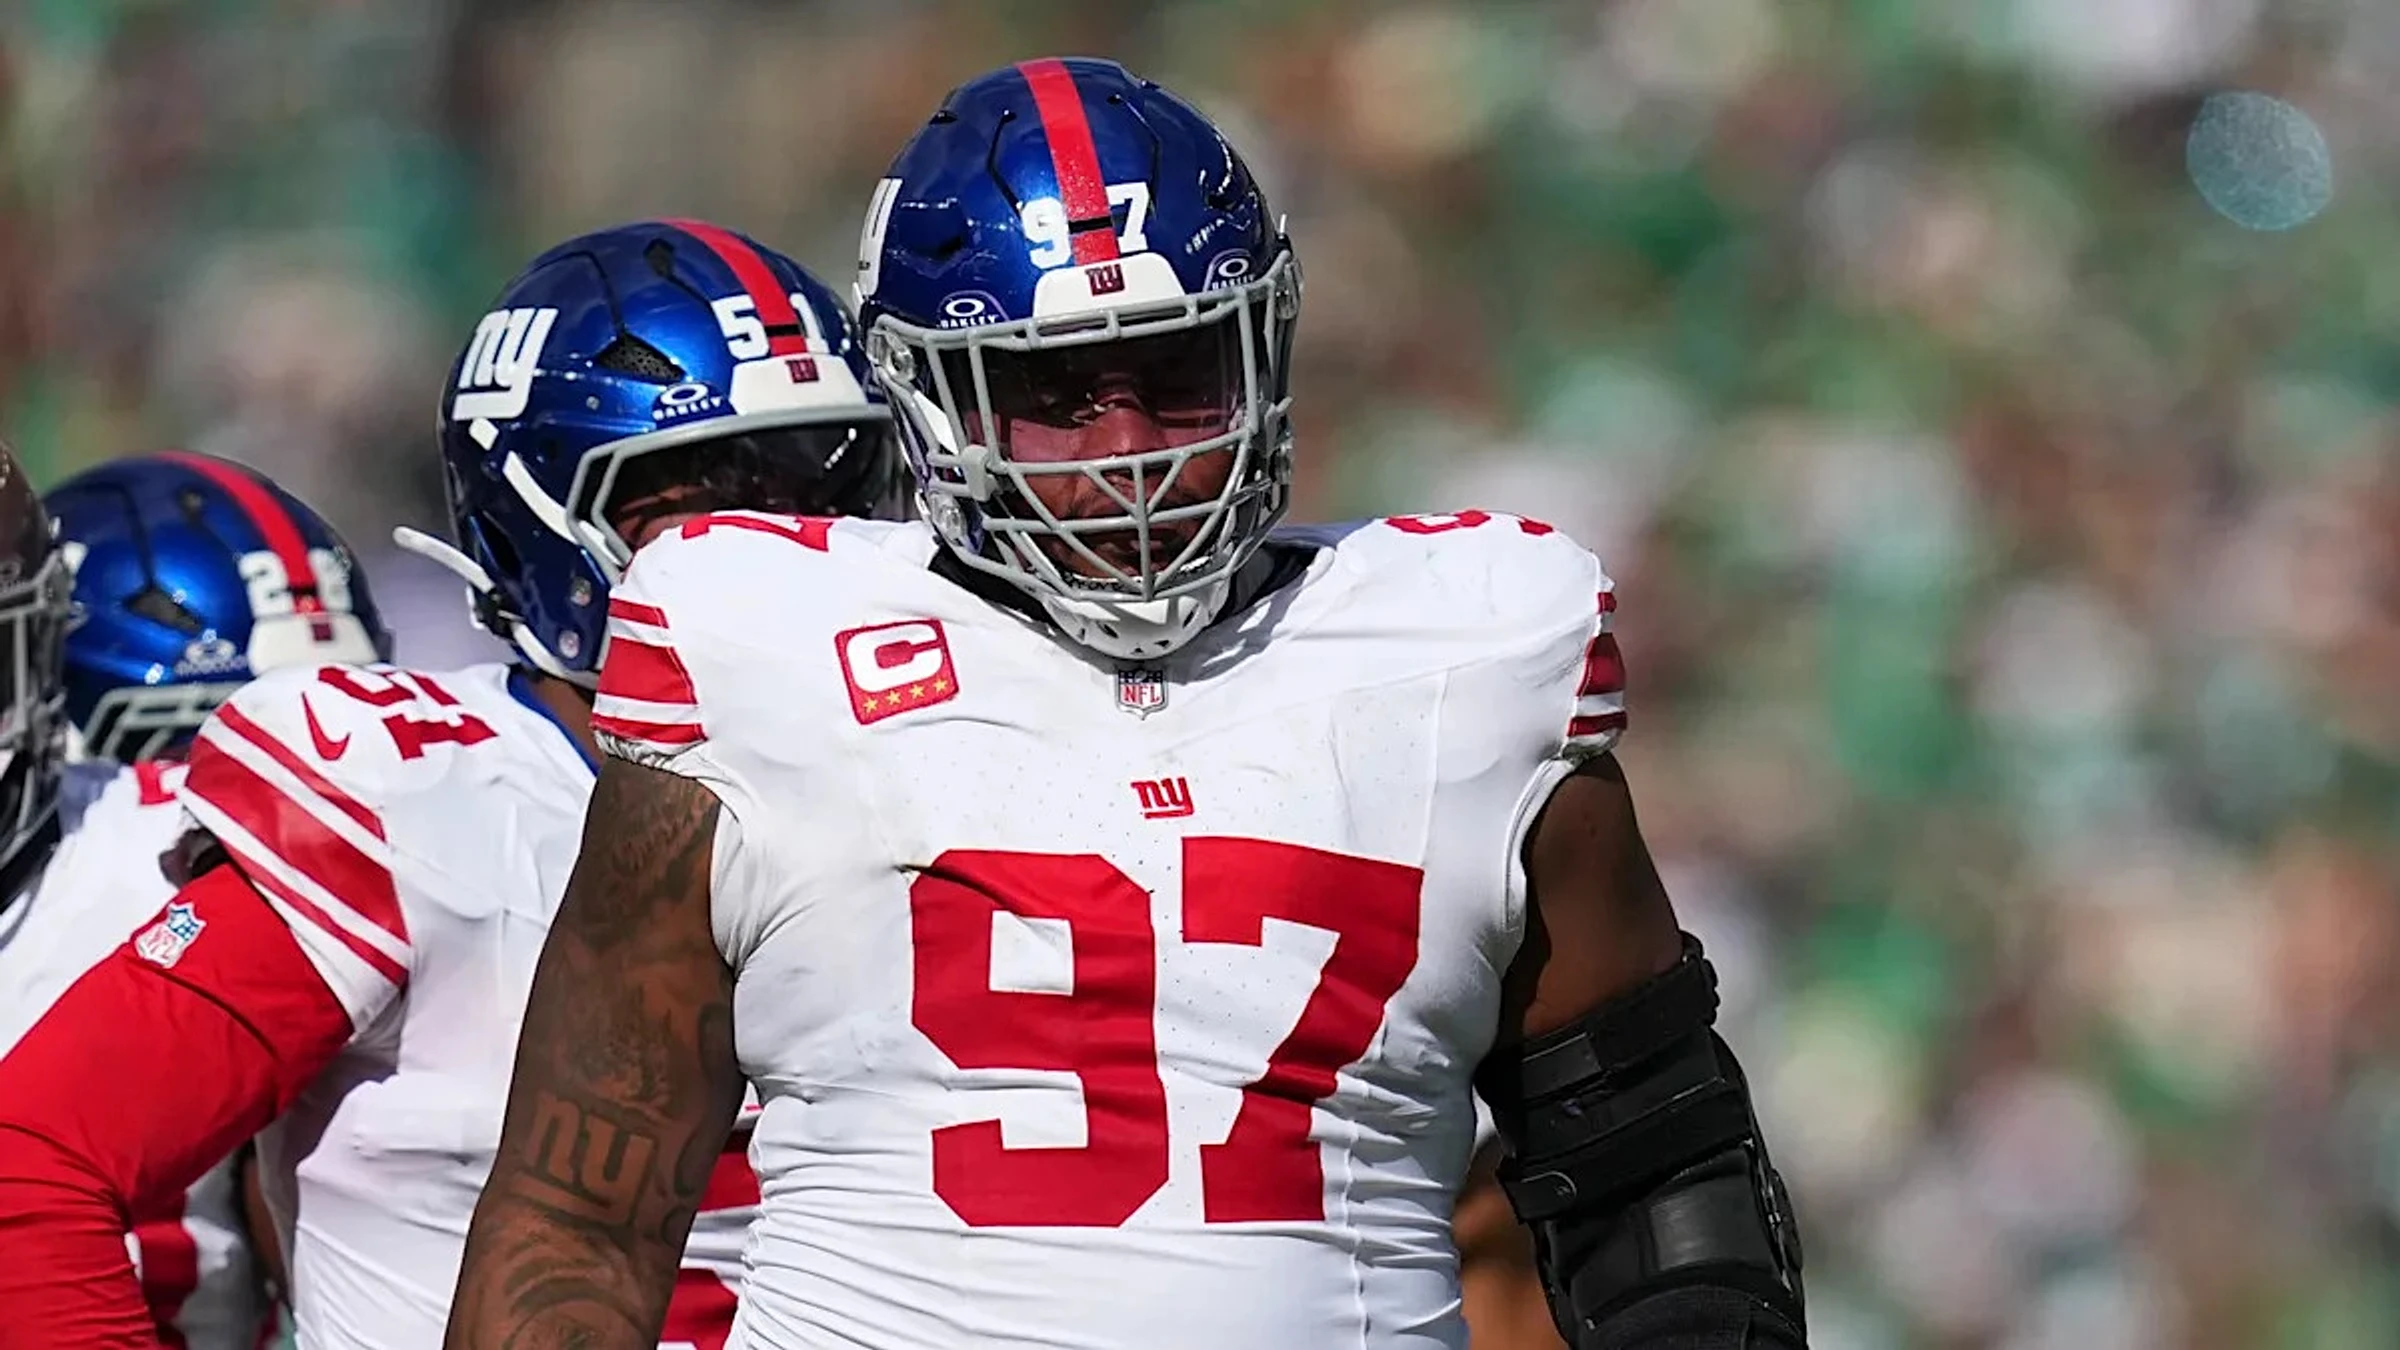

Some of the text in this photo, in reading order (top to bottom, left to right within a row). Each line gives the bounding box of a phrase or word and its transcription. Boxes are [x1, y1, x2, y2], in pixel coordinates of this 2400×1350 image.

[1020, 181, 1150, 270] 97
[710, 292, 830, 361] 51
[939, 313, 1000, 329] OAKLEY
[452, 307, 559, 421] ny
[651, 395, 723, 421] OAKLEY
[845, 623, 945, 693] C
[1124, 684, 1162, 705] NFL
[1130, 776, 1195, 819] ny
[909, 835, 1425, 1228] 97
